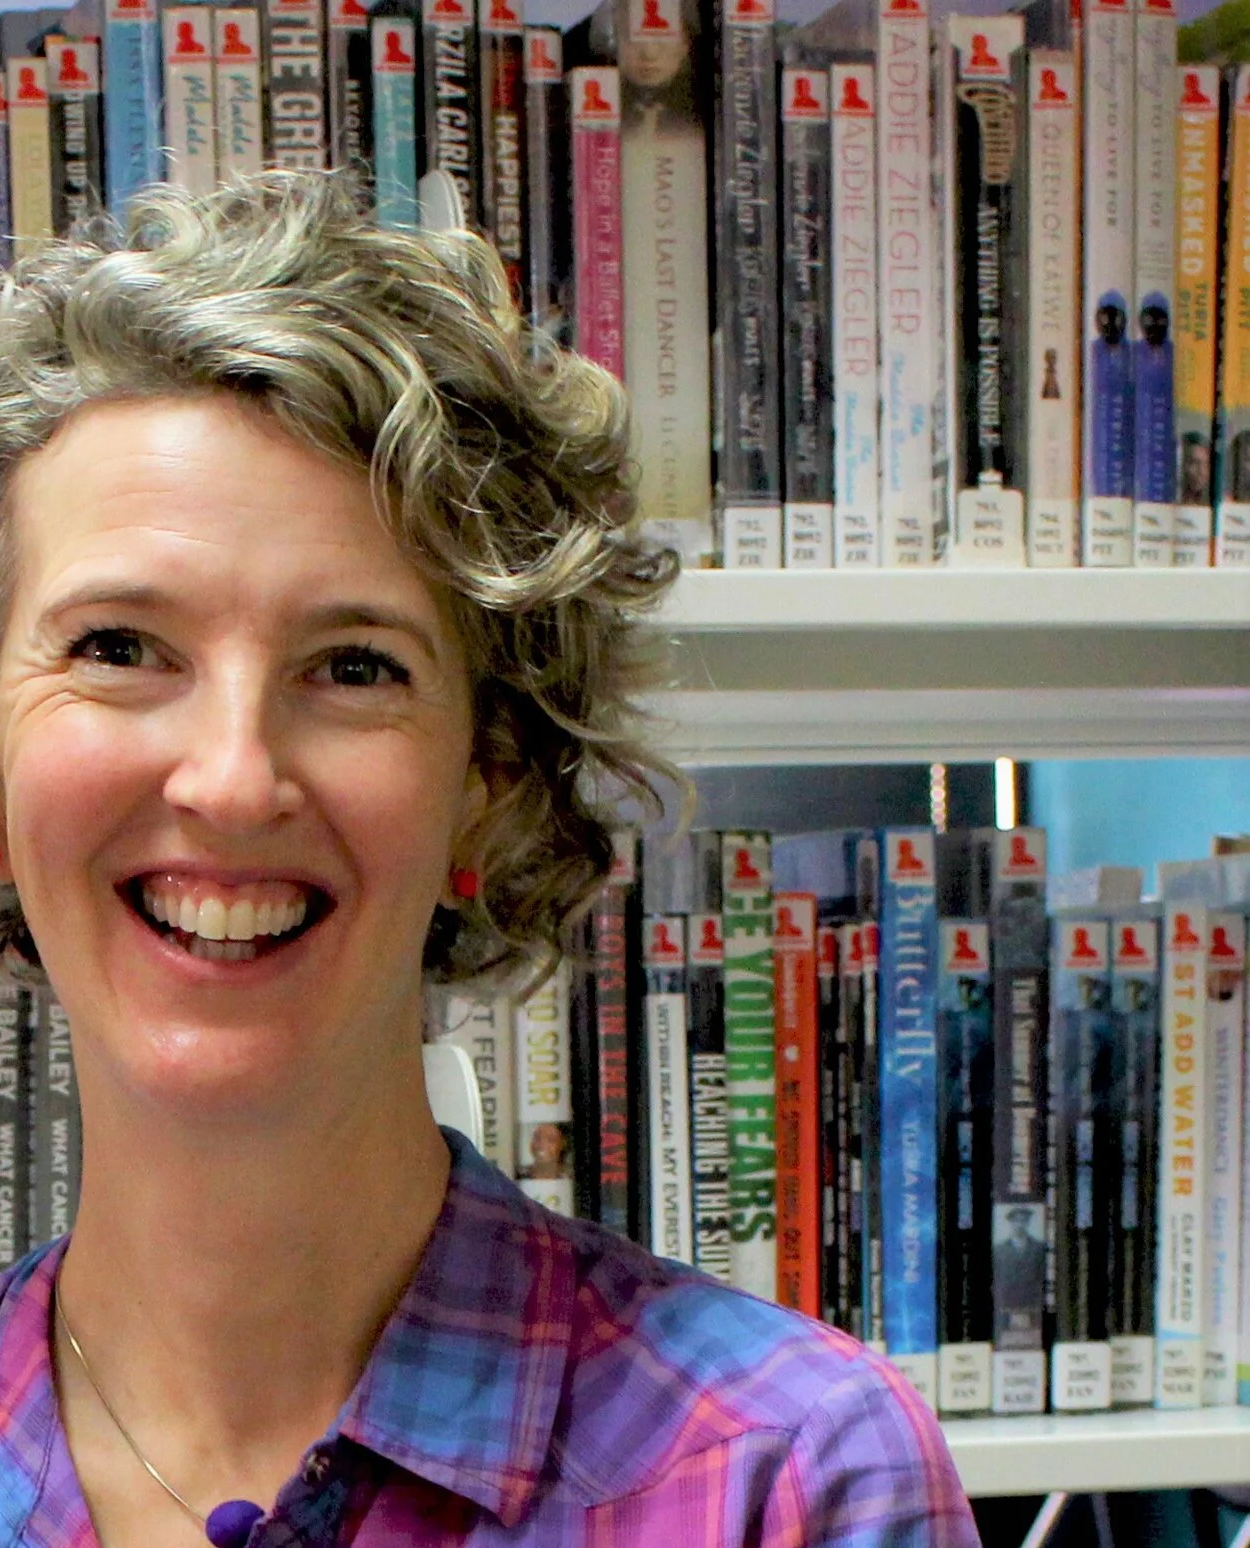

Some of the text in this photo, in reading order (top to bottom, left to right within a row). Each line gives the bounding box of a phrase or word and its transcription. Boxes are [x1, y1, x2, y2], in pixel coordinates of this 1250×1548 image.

[495, 114, 522, 259] HAPPIEST
[591, 147, 618, 323] Hope in Ballet
[1040, 121, 1060, 208] QUEEN
[1041, 213, 1060, 243] OF
[655, 155, 679, 399] MAO'S LAST DANCER
[842, 234, 872, 377] ZIEGLER
[888, 168, 922, 336] ZIEGLER
[978, 204, 1000, 447] ANYTHING IS POSSIBLE
[1192, 283, 1209, 342] TURIA
[596, 914, 628, 1186] BOYS IN THE CAVE
[886, 884, 936, 1080] Butterfly
[47, 1002, 71, 1176] BAILEY WHAT
[525, 1029, 563, 1106] SOAR
[726, 948, 776, 1244] YOUR FEARS
[1171, 1012, 1197, 1198] ADD WATER
[661, 1147, 681, 1258] MY EVEREST
[692, 1181, 730, 1225] THE
